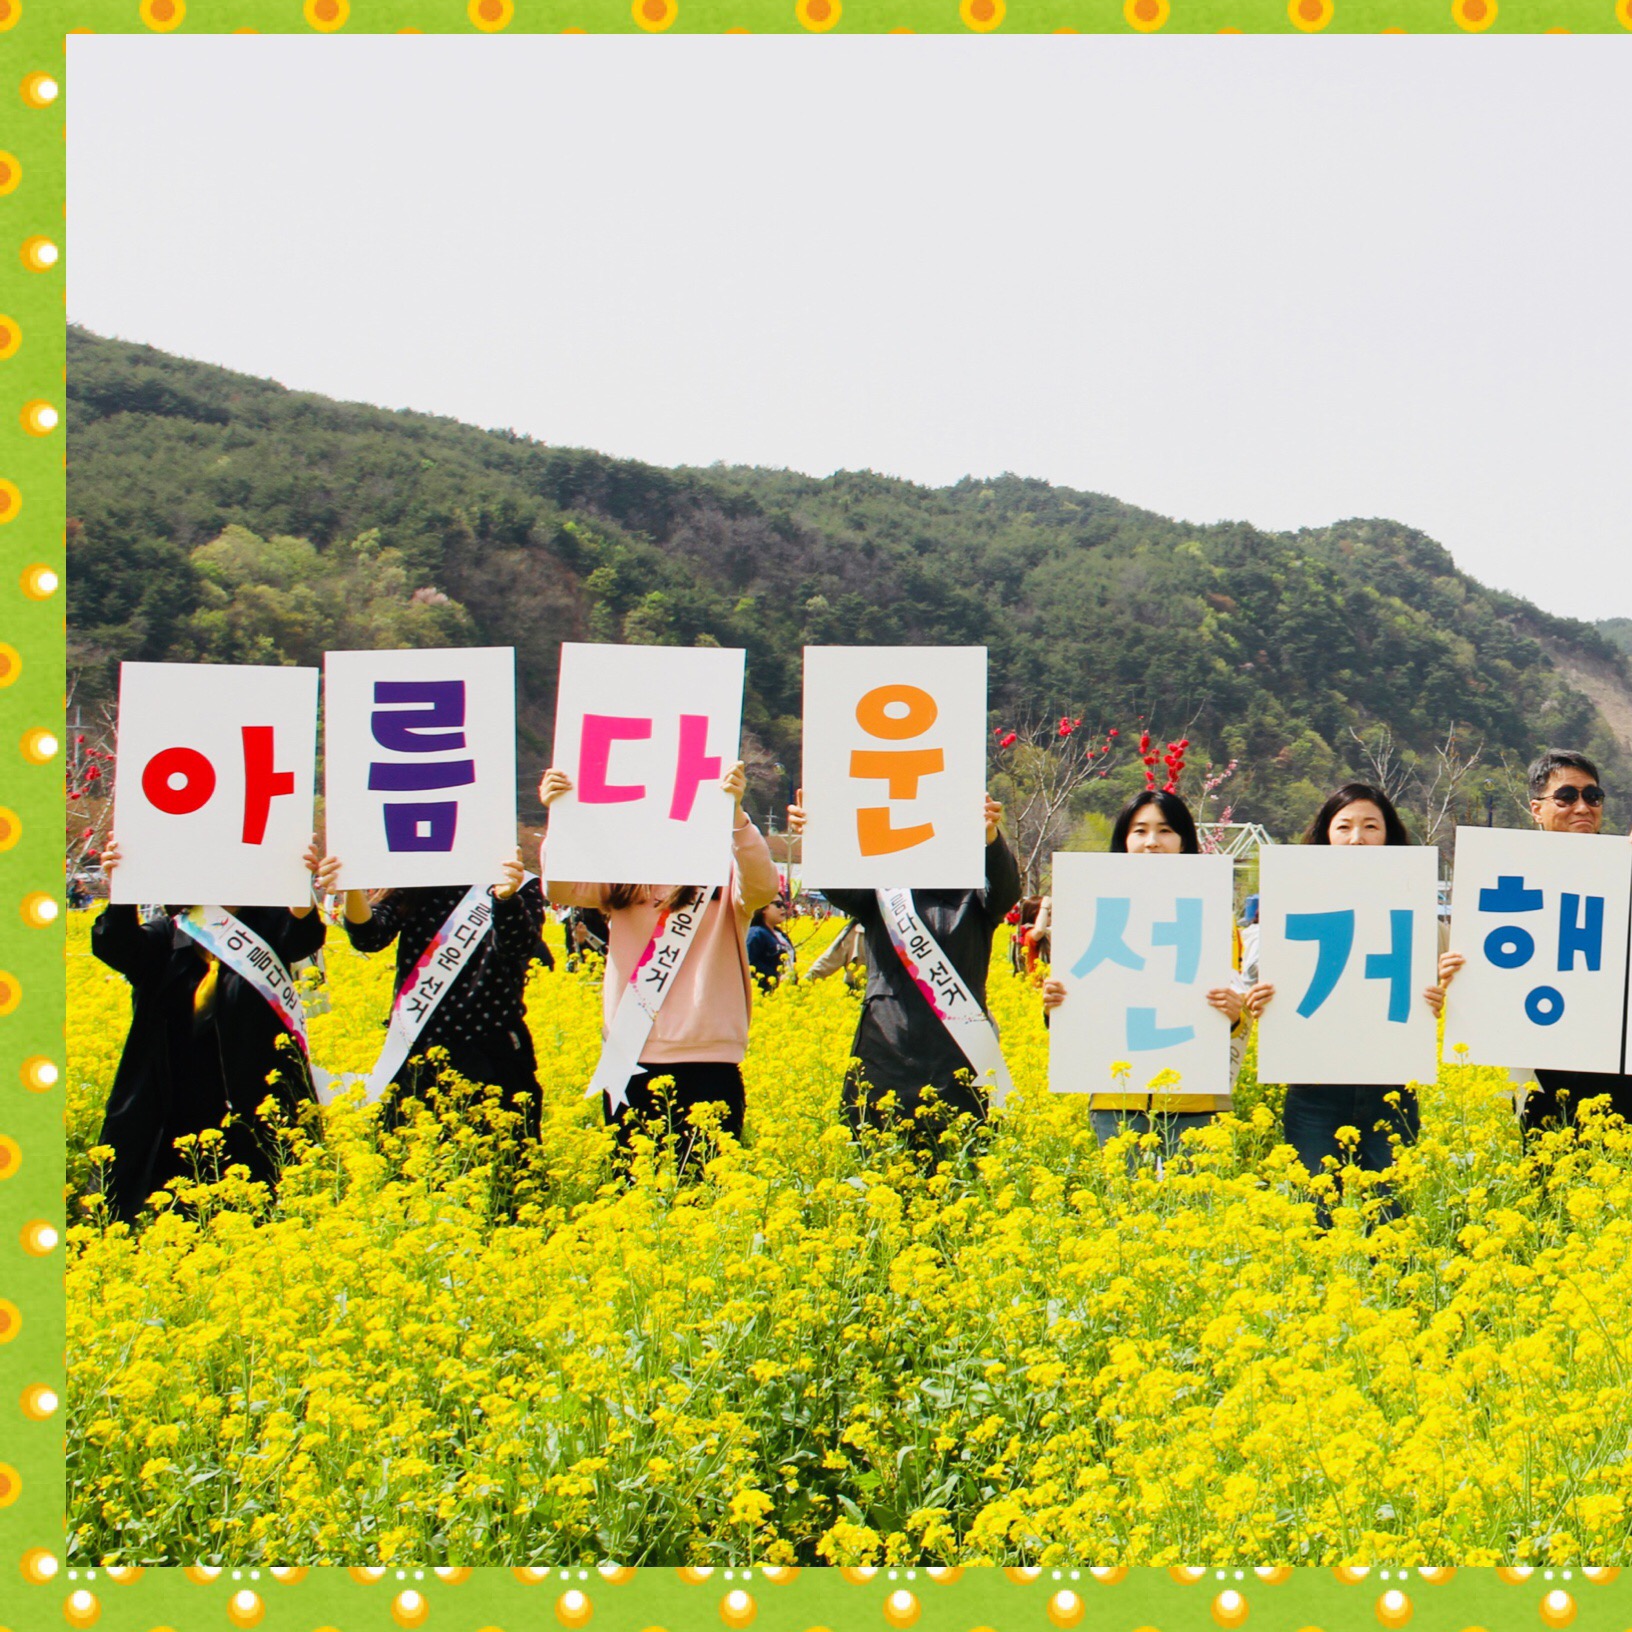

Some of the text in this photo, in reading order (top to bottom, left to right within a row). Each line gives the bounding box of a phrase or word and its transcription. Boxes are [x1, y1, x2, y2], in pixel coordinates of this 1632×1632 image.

[141, 725, 295, 846] 아
[367, 679, 476, 853] 름
[577, 713, 722, 822] 다
[849, 683, 945, 857] 운
[227, 928, 298, 1010] 아름다운
[406, 976, 444, 1023] 선거
[645, 944, 681, 993] 선거
[885, 888, 967, 1006] 름다운 선거
[1071, 897, 1203, 1052] 선
[1285, 909, 1414, 1024] 거
[1478, 875, 1605, 1027] 행
